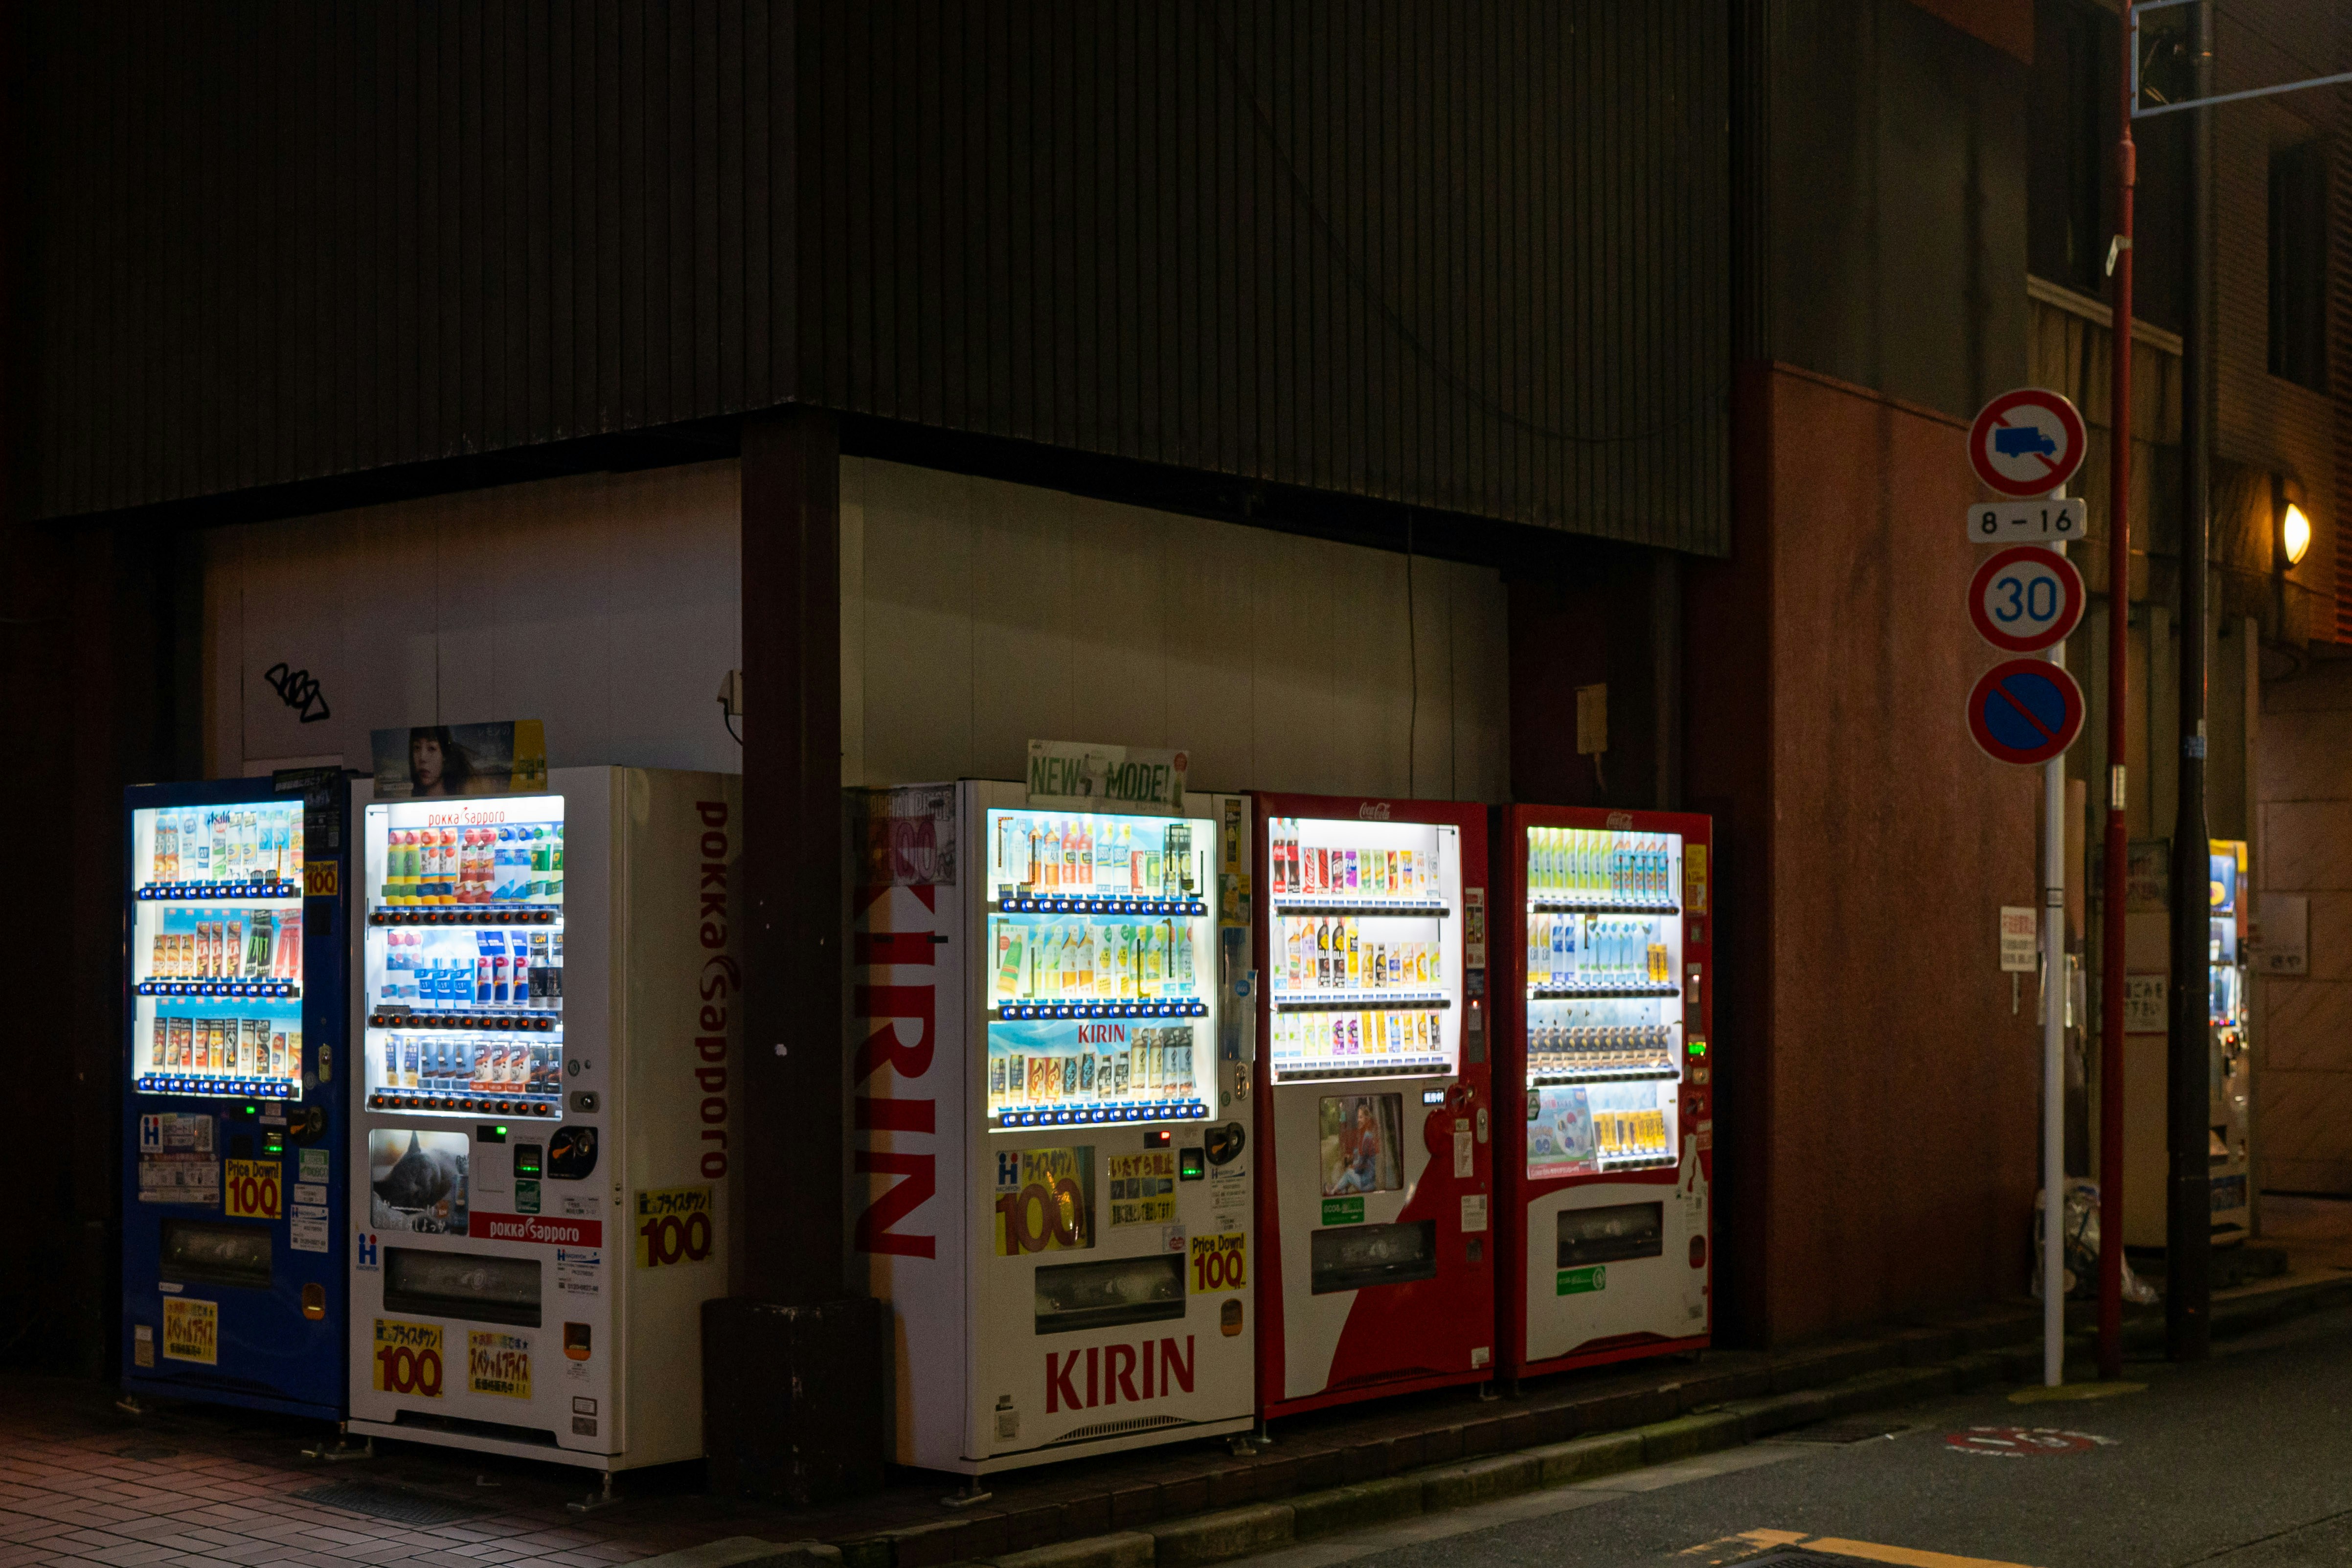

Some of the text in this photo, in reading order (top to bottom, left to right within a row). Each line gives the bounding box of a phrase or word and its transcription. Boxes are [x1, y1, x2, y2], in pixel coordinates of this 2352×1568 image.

[1995, 576, 2057, 622] 30
[1031, 755, 1082, 796] NEW
[207, 810, 230, 824] Asahi
[429, 810, 505, 827] pokka sapporo
[695, 801, 728, 1180] pokka sapporo
[854, 816, 935, 1259] KIRIN
[1079, 1024, 1125, 1044] KIRIN
[227, 1160, 279, 1179] Price Down!
[229, 1177, 277, 1215] 100
[996, 1178, 1083, 1255] 100
[490, 1221, 580, 1243] pokka sapporo
[641, 1212, 711, 1267] 100
[1193, 1237, 1215, 1253] Price
[1218, 1232, 1244, 1251] Down!
[1194, 1250, 1243, 1291] 100
[377, 1345, 443, 1397] 100
[1046, 1335, 1195, 1414] KIRIN
